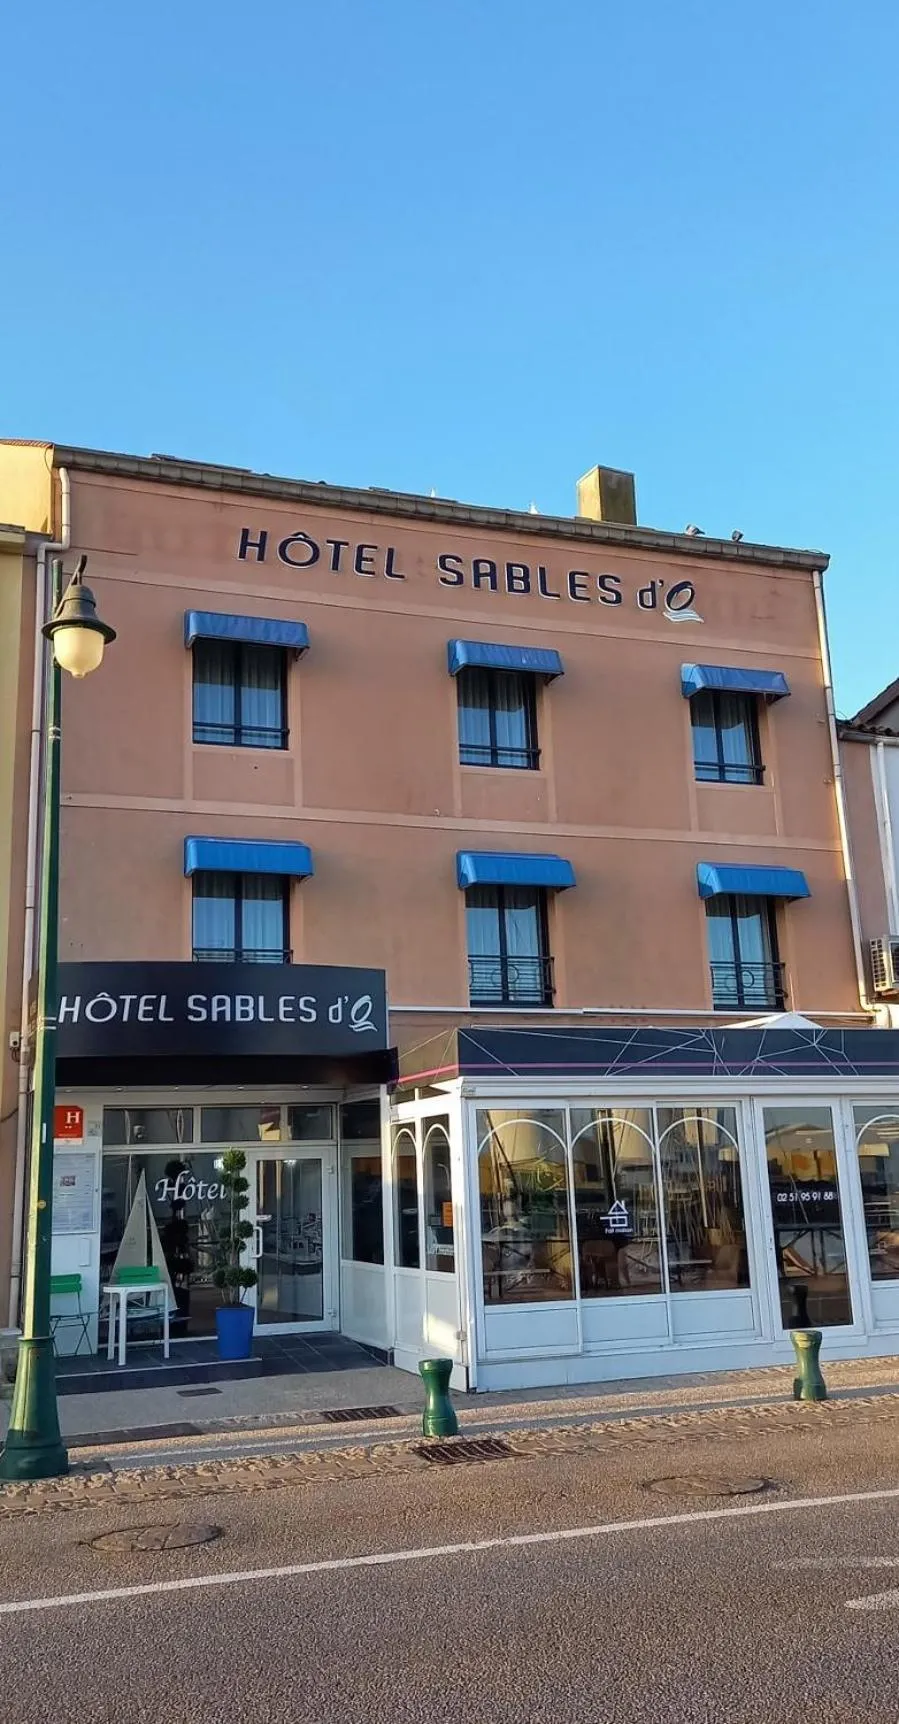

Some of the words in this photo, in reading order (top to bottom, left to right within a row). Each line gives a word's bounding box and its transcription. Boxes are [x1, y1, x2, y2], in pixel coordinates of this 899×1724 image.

[237, 527, 406, 580] HÔTEL
[437, 554, 622, 606] SABLES
[57, 992, 175, 1023] HÔTEL
[187, 994, 317, 1023] SABLES
[65, 1110, 81, 1124] H
[776, 1192, 788, 1202] 02
[789, 1192, 799, 1202] 51
[800, 1191, 811, 1201] 95
[812, 1191, 821, 1201] 91
